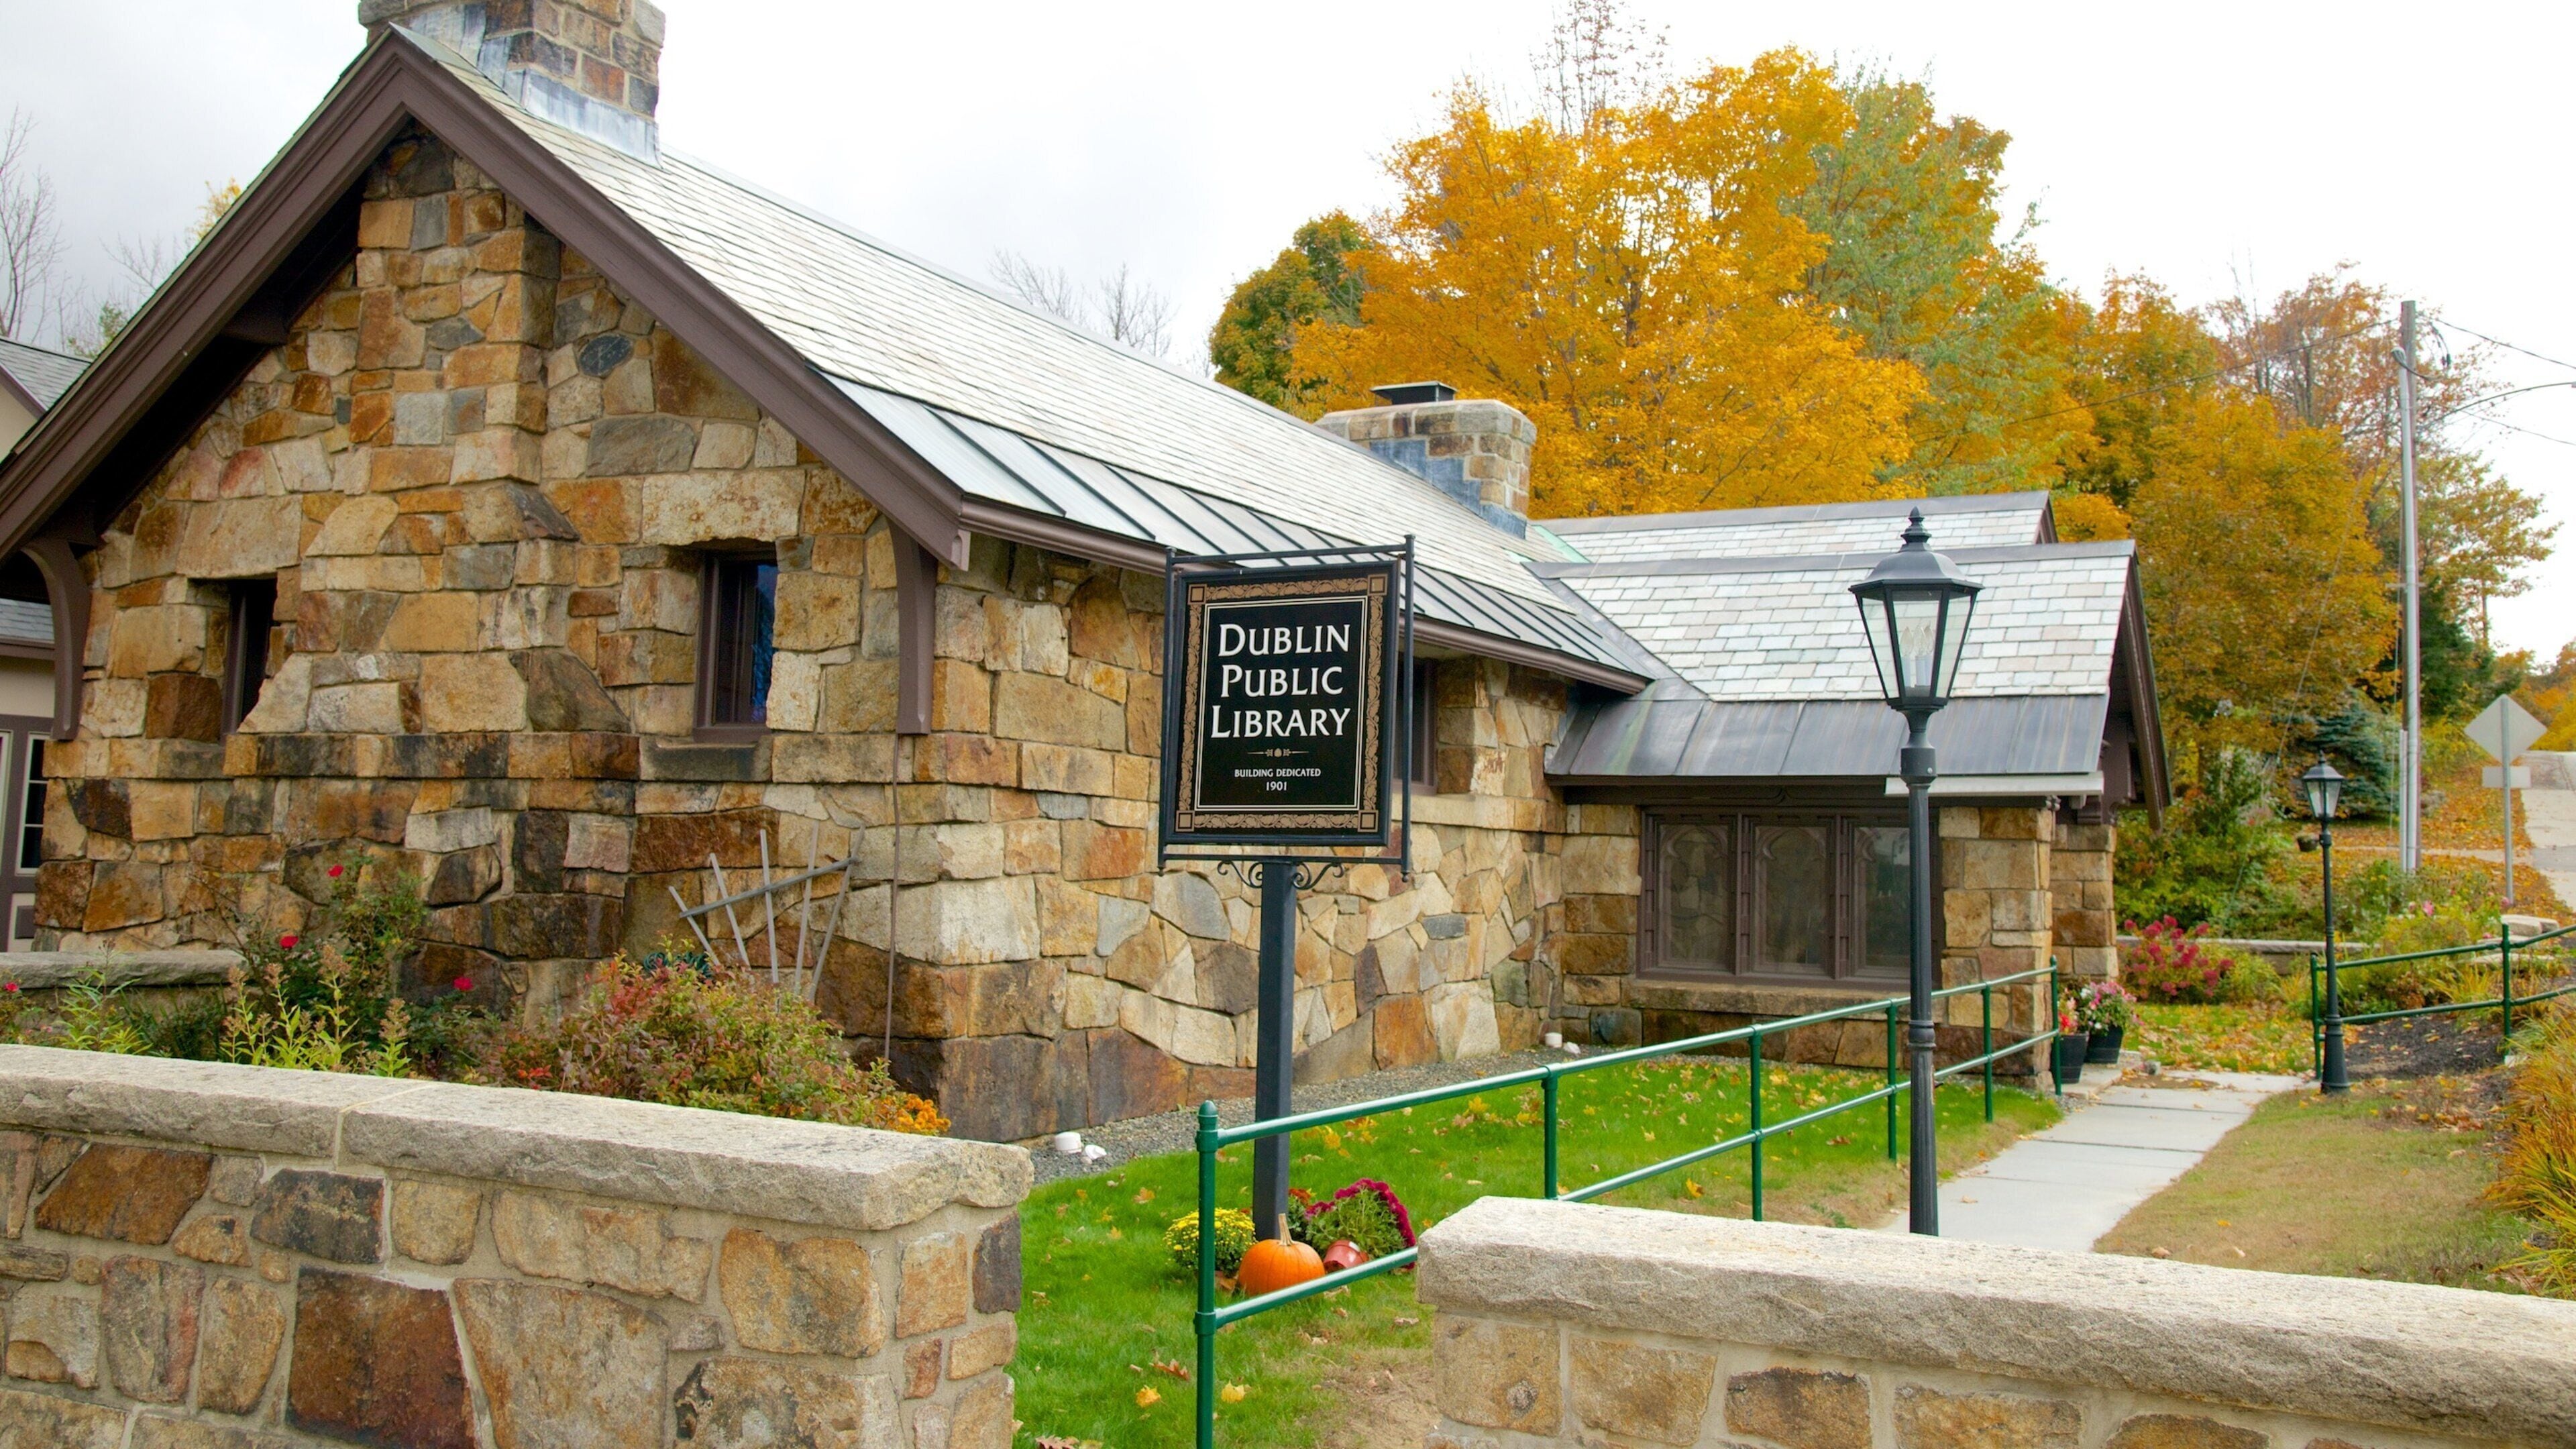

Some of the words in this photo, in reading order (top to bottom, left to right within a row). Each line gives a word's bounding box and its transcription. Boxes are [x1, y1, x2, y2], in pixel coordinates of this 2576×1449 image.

[1218, 623, 1350, 657] DUBLIN
[1220, 664, 1343, 698] PUBLIC
[1211, 705, 1351, 738] LIBRARY
[1234, 768, 1274, 777] BUILDING
[1276, 768, 1322, 777] DEDICATED
[1266, 781, 1287, 791] 1901
